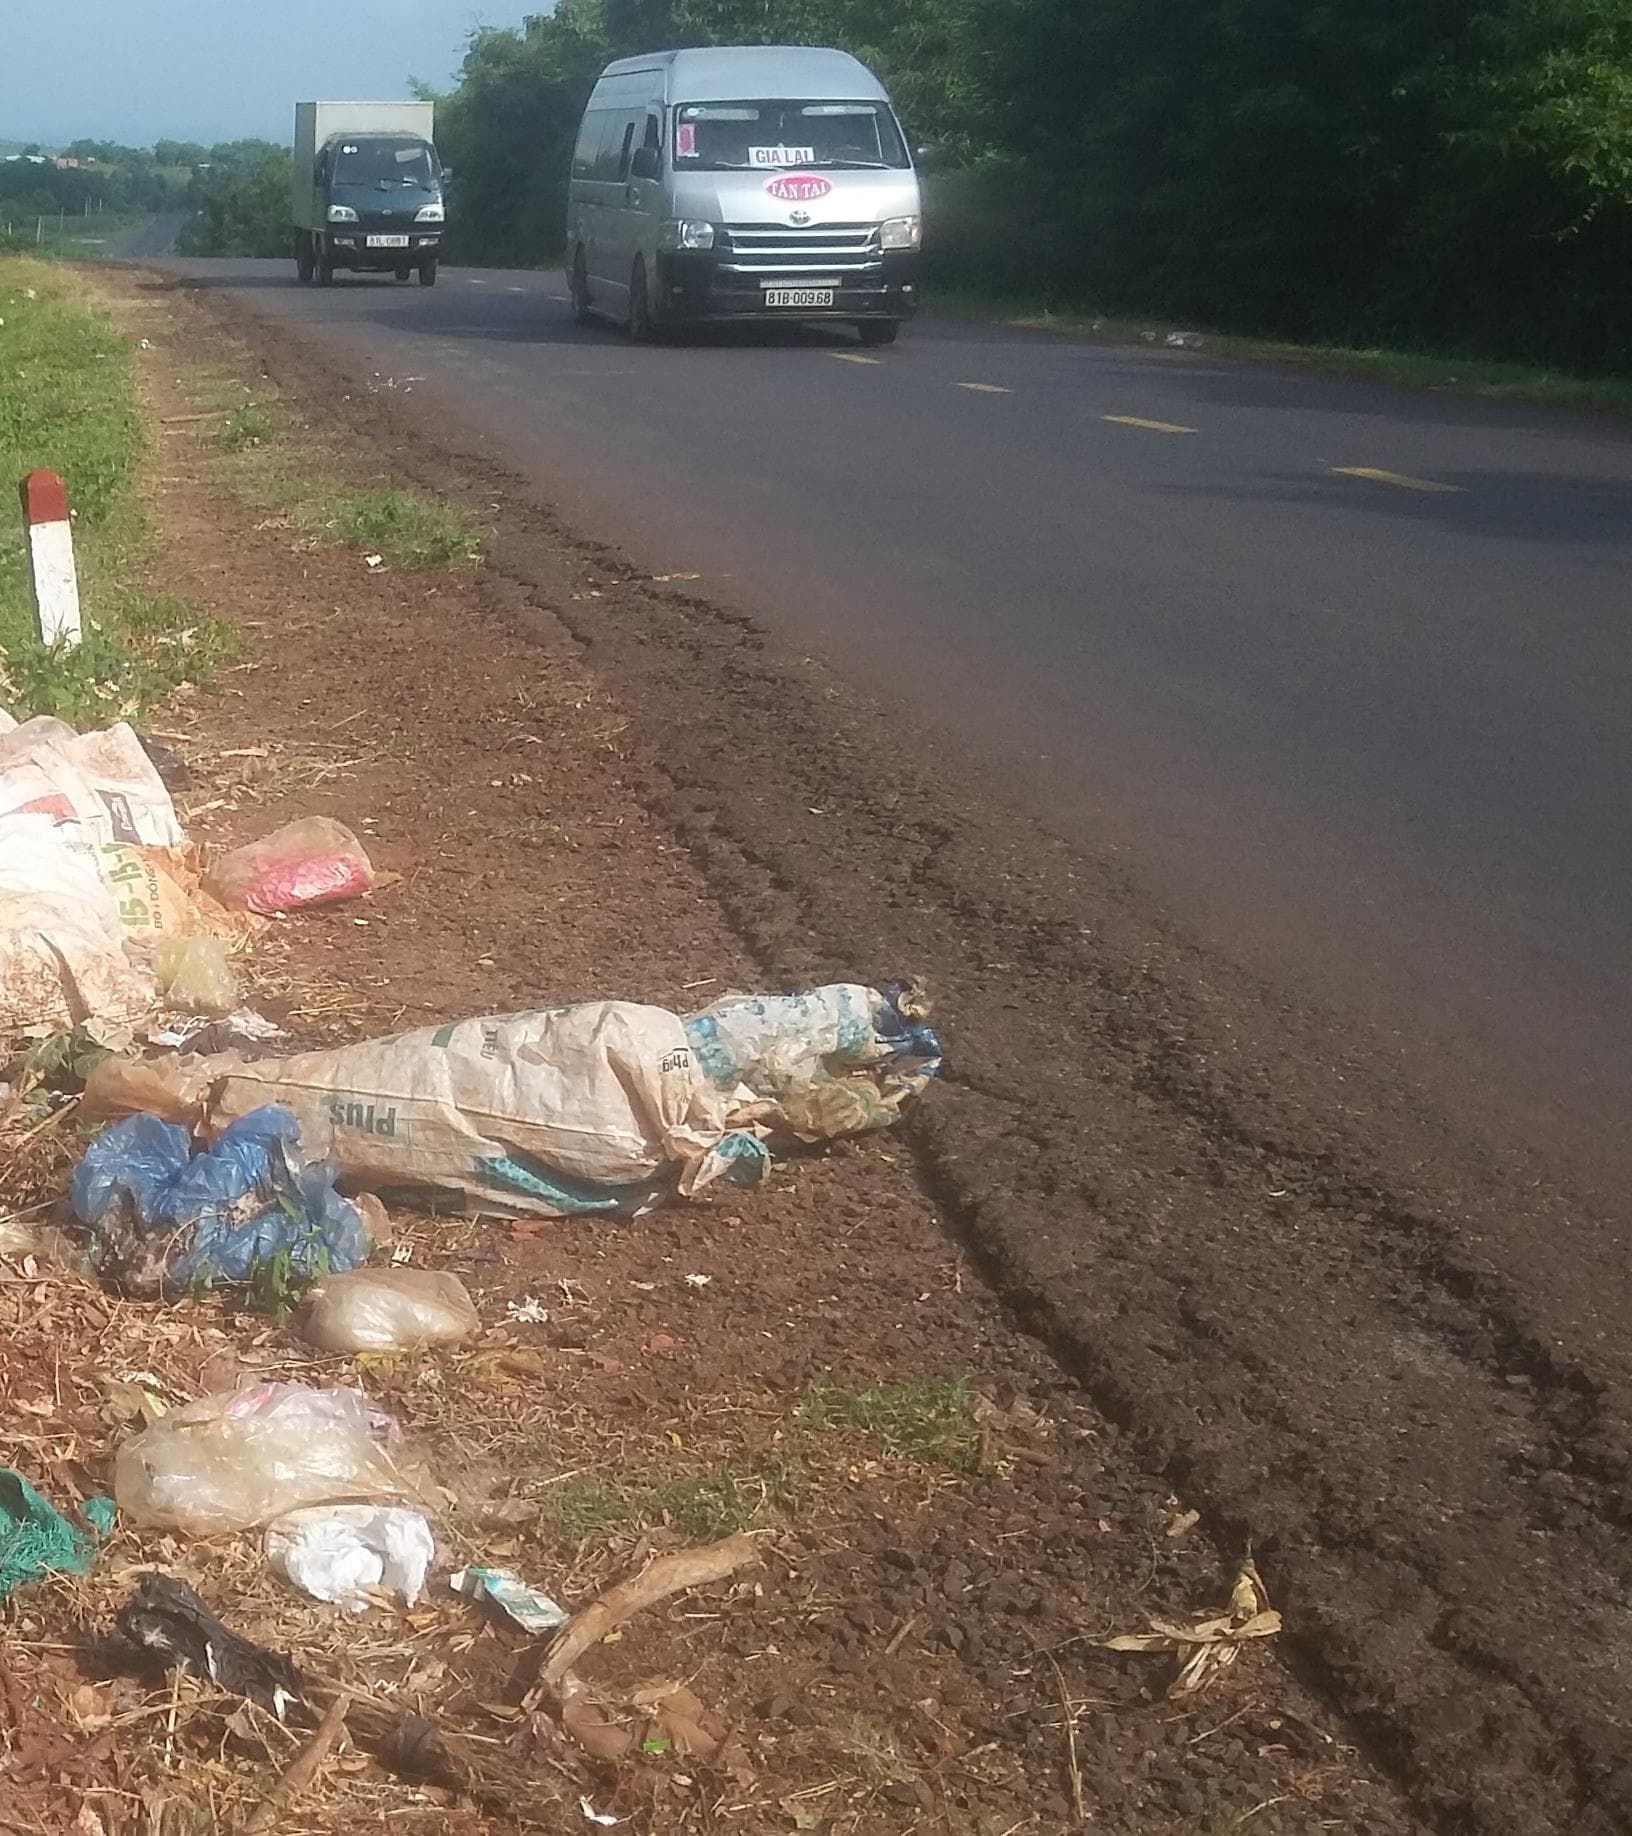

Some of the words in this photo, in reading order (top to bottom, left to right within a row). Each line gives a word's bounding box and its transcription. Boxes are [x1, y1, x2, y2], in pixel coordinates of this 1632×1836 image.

[756, 149, 781, 163] GIA
[785, 150, 809, 163] LAI
[329, 1104, 396, 1137] Plus
